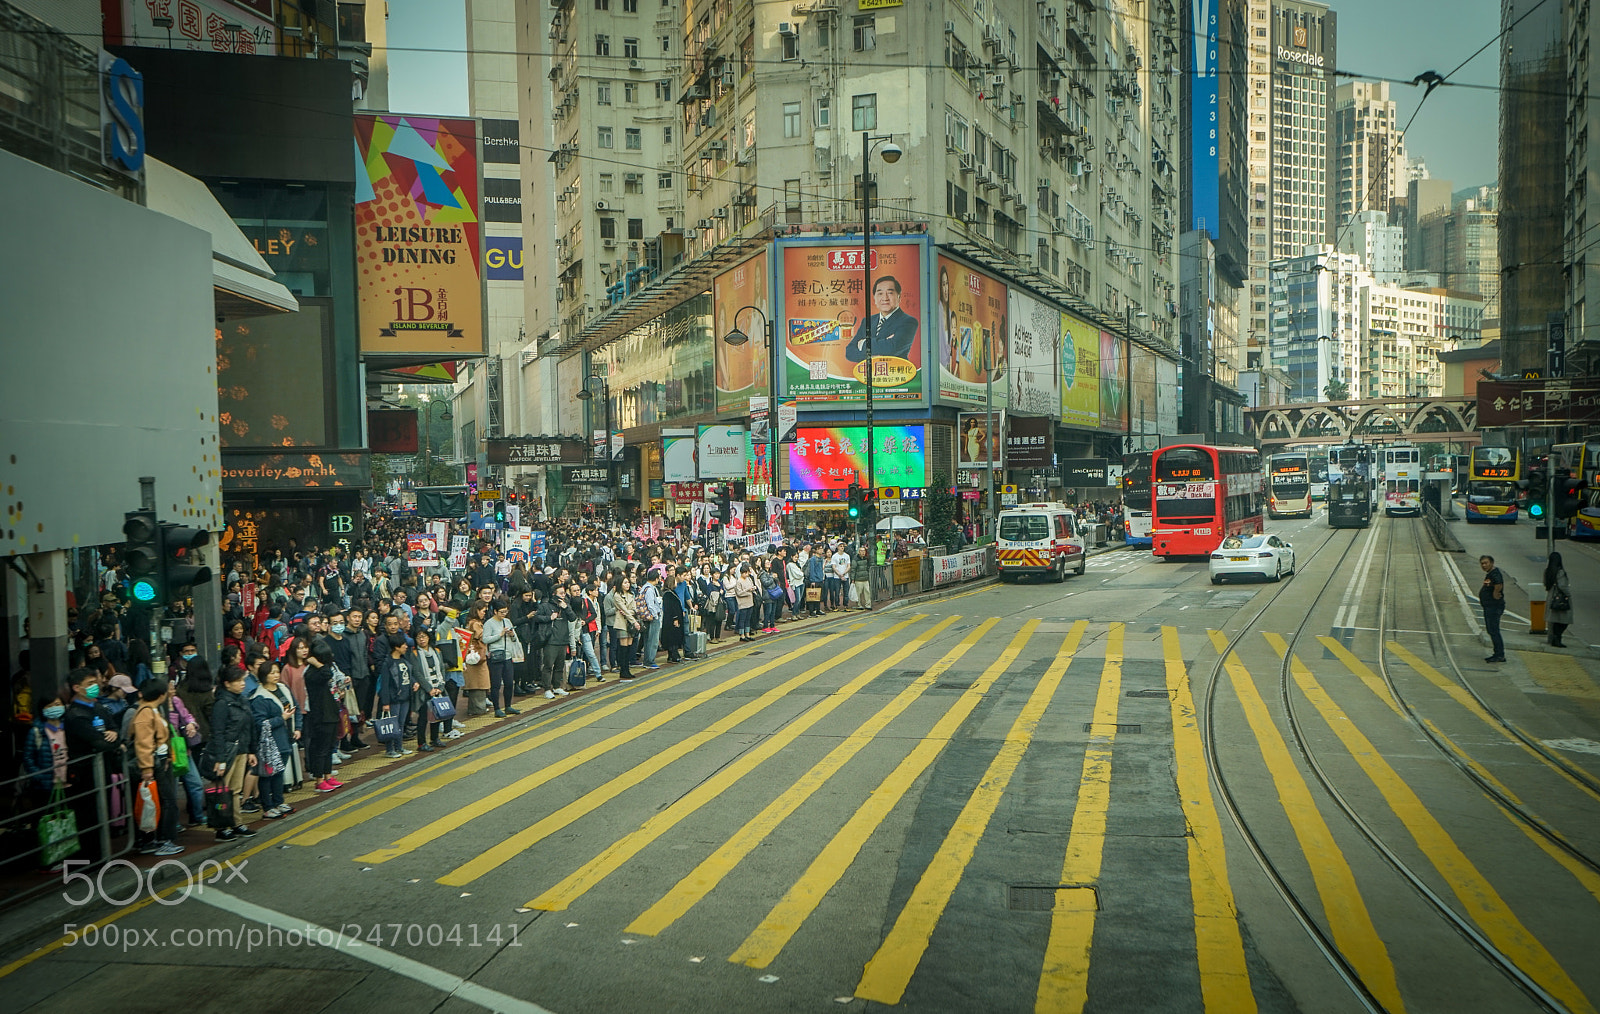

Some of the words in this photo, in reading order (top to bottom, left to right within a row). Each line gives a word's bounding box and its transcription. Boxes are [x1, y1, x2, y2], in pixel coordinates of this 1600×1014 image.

[1277, 45, 1325, 68] Rosedale
[110, 58, 145, 171] S
[1209, 93, 1217, 157] 2388
[484, 136, 519, 147] Bershka
[484, 196, 522, 205] PULL&BEAR
[375, 226, 463, 245] LEISURE
[383, 248, 456, 265] DINING
[485, 247, 524, 270] GU
[393, 287, 435, 322] iB
[436, 288, 448, 322] 金百利
[1493, 395, 1534, 412] 余仁生
[509, 443, 562, 457] 六福珠寶
[571, 469, 608, 479] 六福珠寶
[784, 490, 820, 501] 政府註冊
[884, 505, 897, 513] 全日
[331, 514, 354, 533] iB
[1193, 527, 1212, 536] KMB
[510, 551, 524, 562] 78
[438, 701, 450, 711] GAP
[380, 723, 394, 735] GAP
